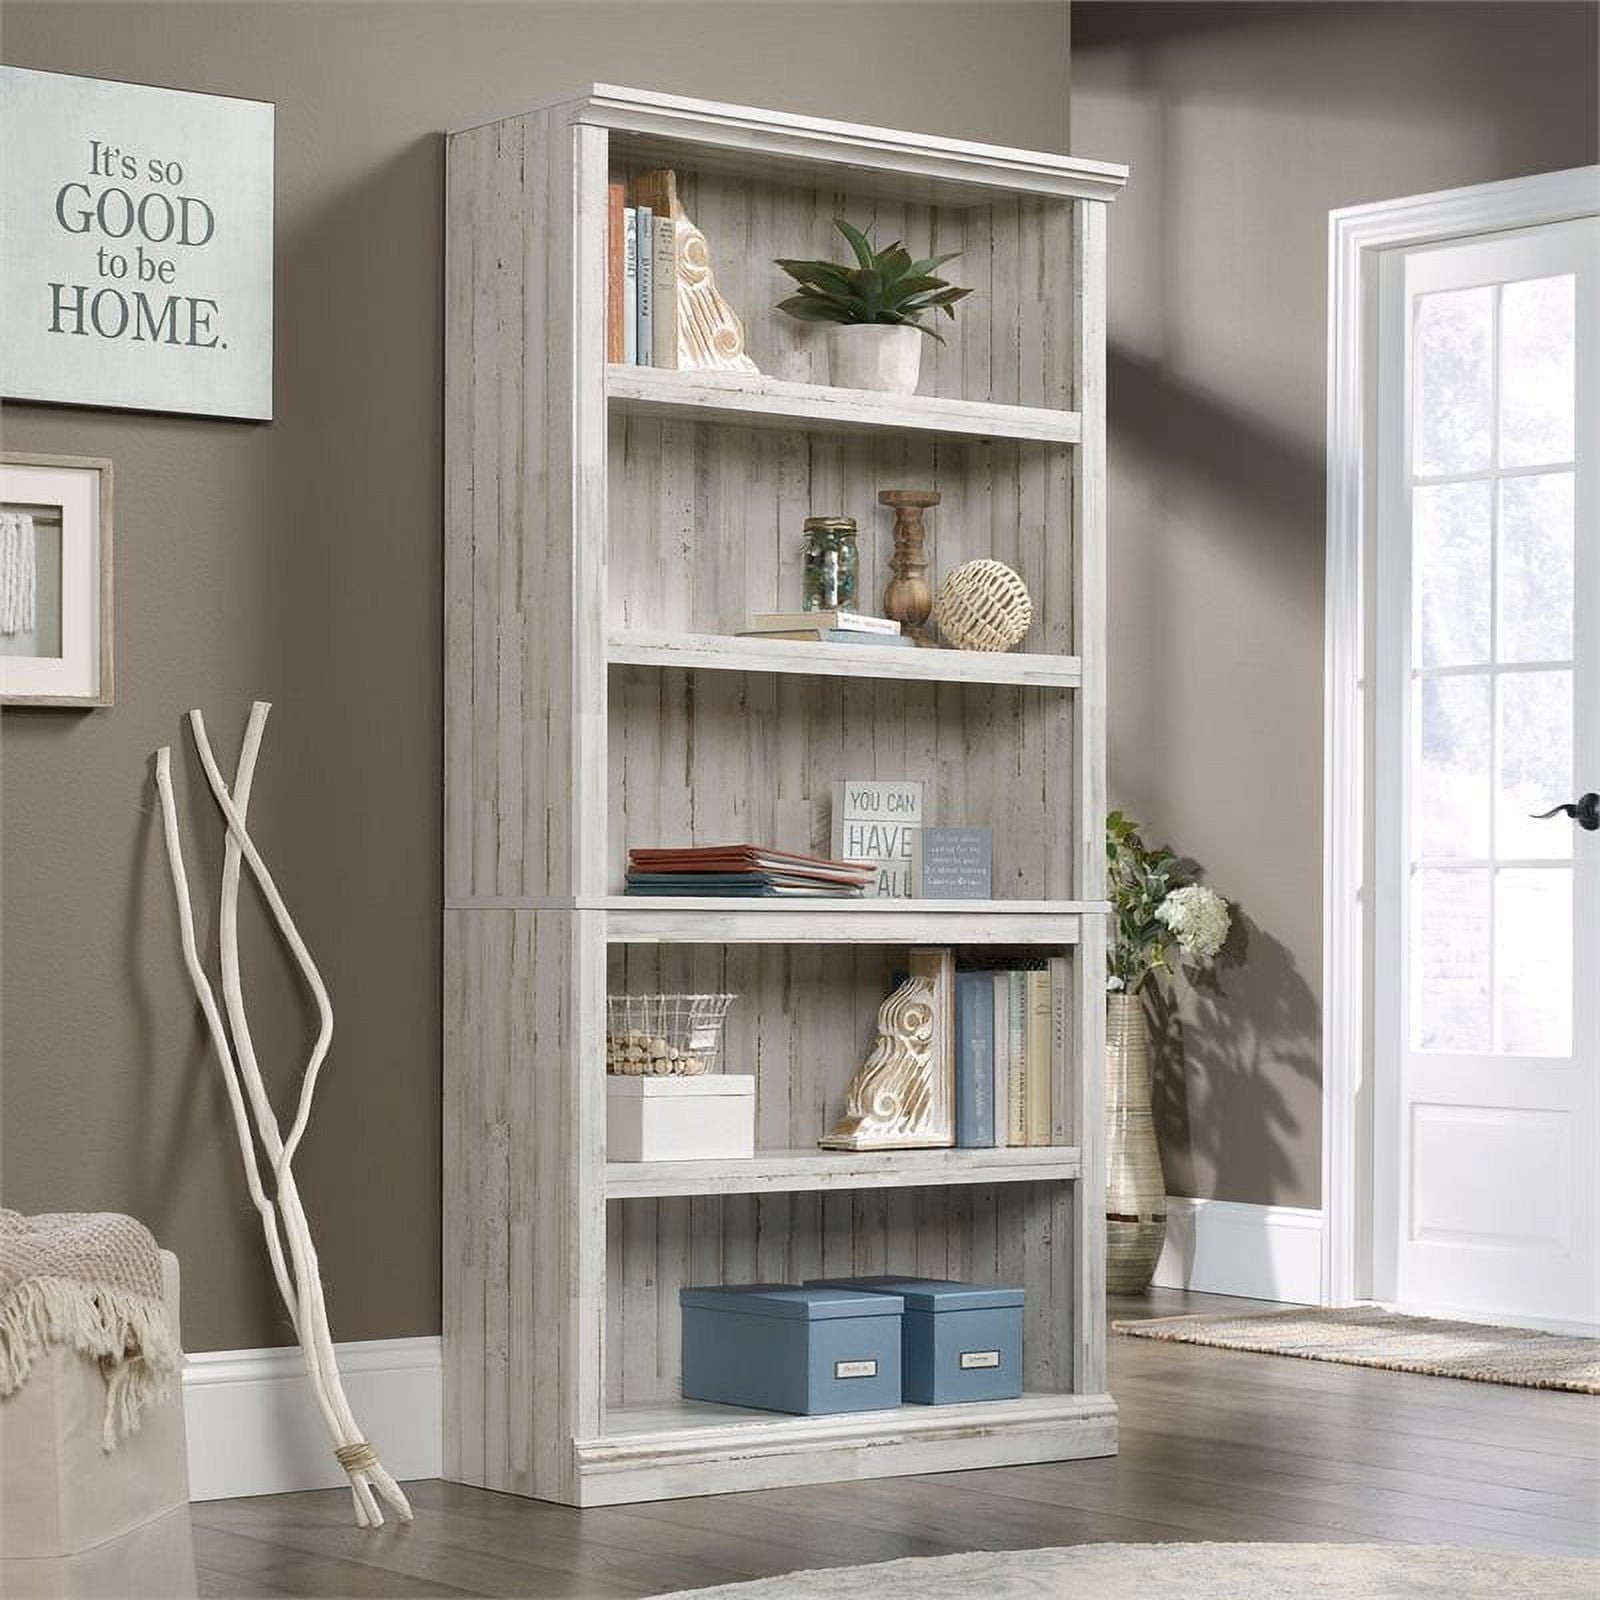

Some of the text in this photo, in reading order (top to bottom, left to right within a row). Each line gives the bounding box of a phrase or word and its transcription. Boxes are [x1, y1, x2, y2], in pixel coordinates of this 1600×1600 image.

[89, 140, 183, 185] It's so
[56, 182, 215, 246] GOOD
[97, 246, 176, 284] to be
[48, 283, 228, 350] HOME.
[850, 790, 915, 813] YOU CAN
[849, 825, 913, 858] HAVE
